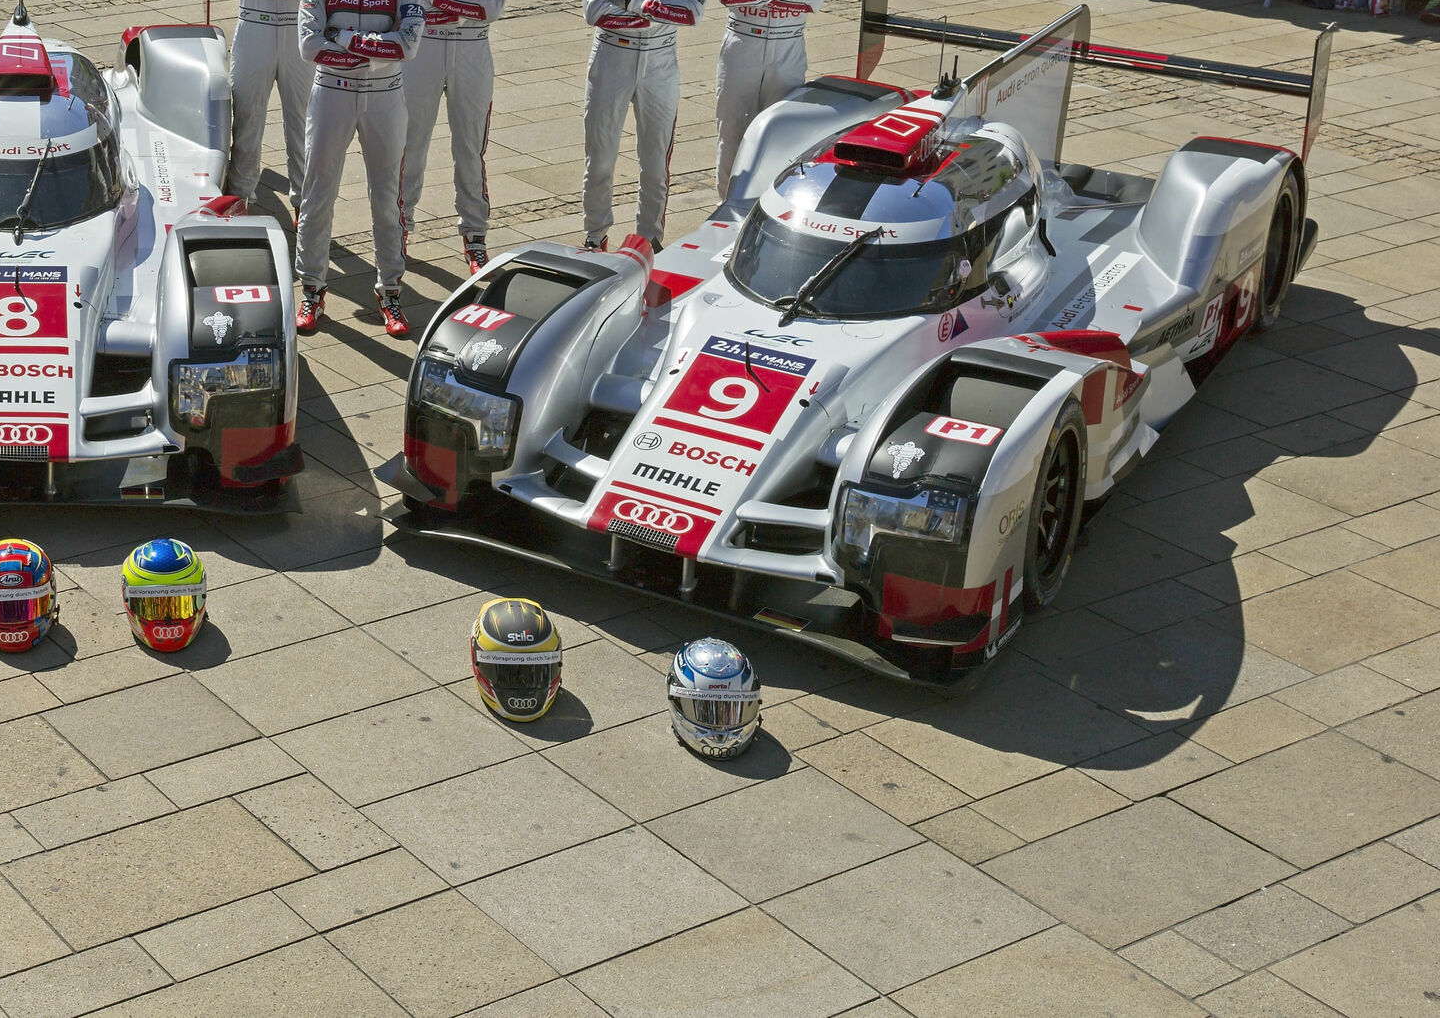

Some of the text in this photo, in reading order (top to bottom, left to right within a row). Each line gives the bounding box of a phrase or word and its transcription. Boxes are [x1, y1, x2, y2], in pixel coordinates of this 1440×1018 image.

[739, 6, 800, 18] quattro
[26, 141, 72, 157] Sport
[21, 271, 63, 279] MANS
[225, 288, 261, 300] P1
[1051, 262, 1126, 330] Audi e-tron quattro
[453, 304, 512, 329] HY
[710, 340, 741, 355] 24h
[762, 355, 806, 371] MANS
[698, 376, 760, 420] 9
[939, 420, 989, 440] P1
[668, 441, 757, 476] BOSCH
[631, 462, 722, 497] MAHLE
[998, 499, 1026, 535] ORIS
[708, 681, 731, 690] porta!
